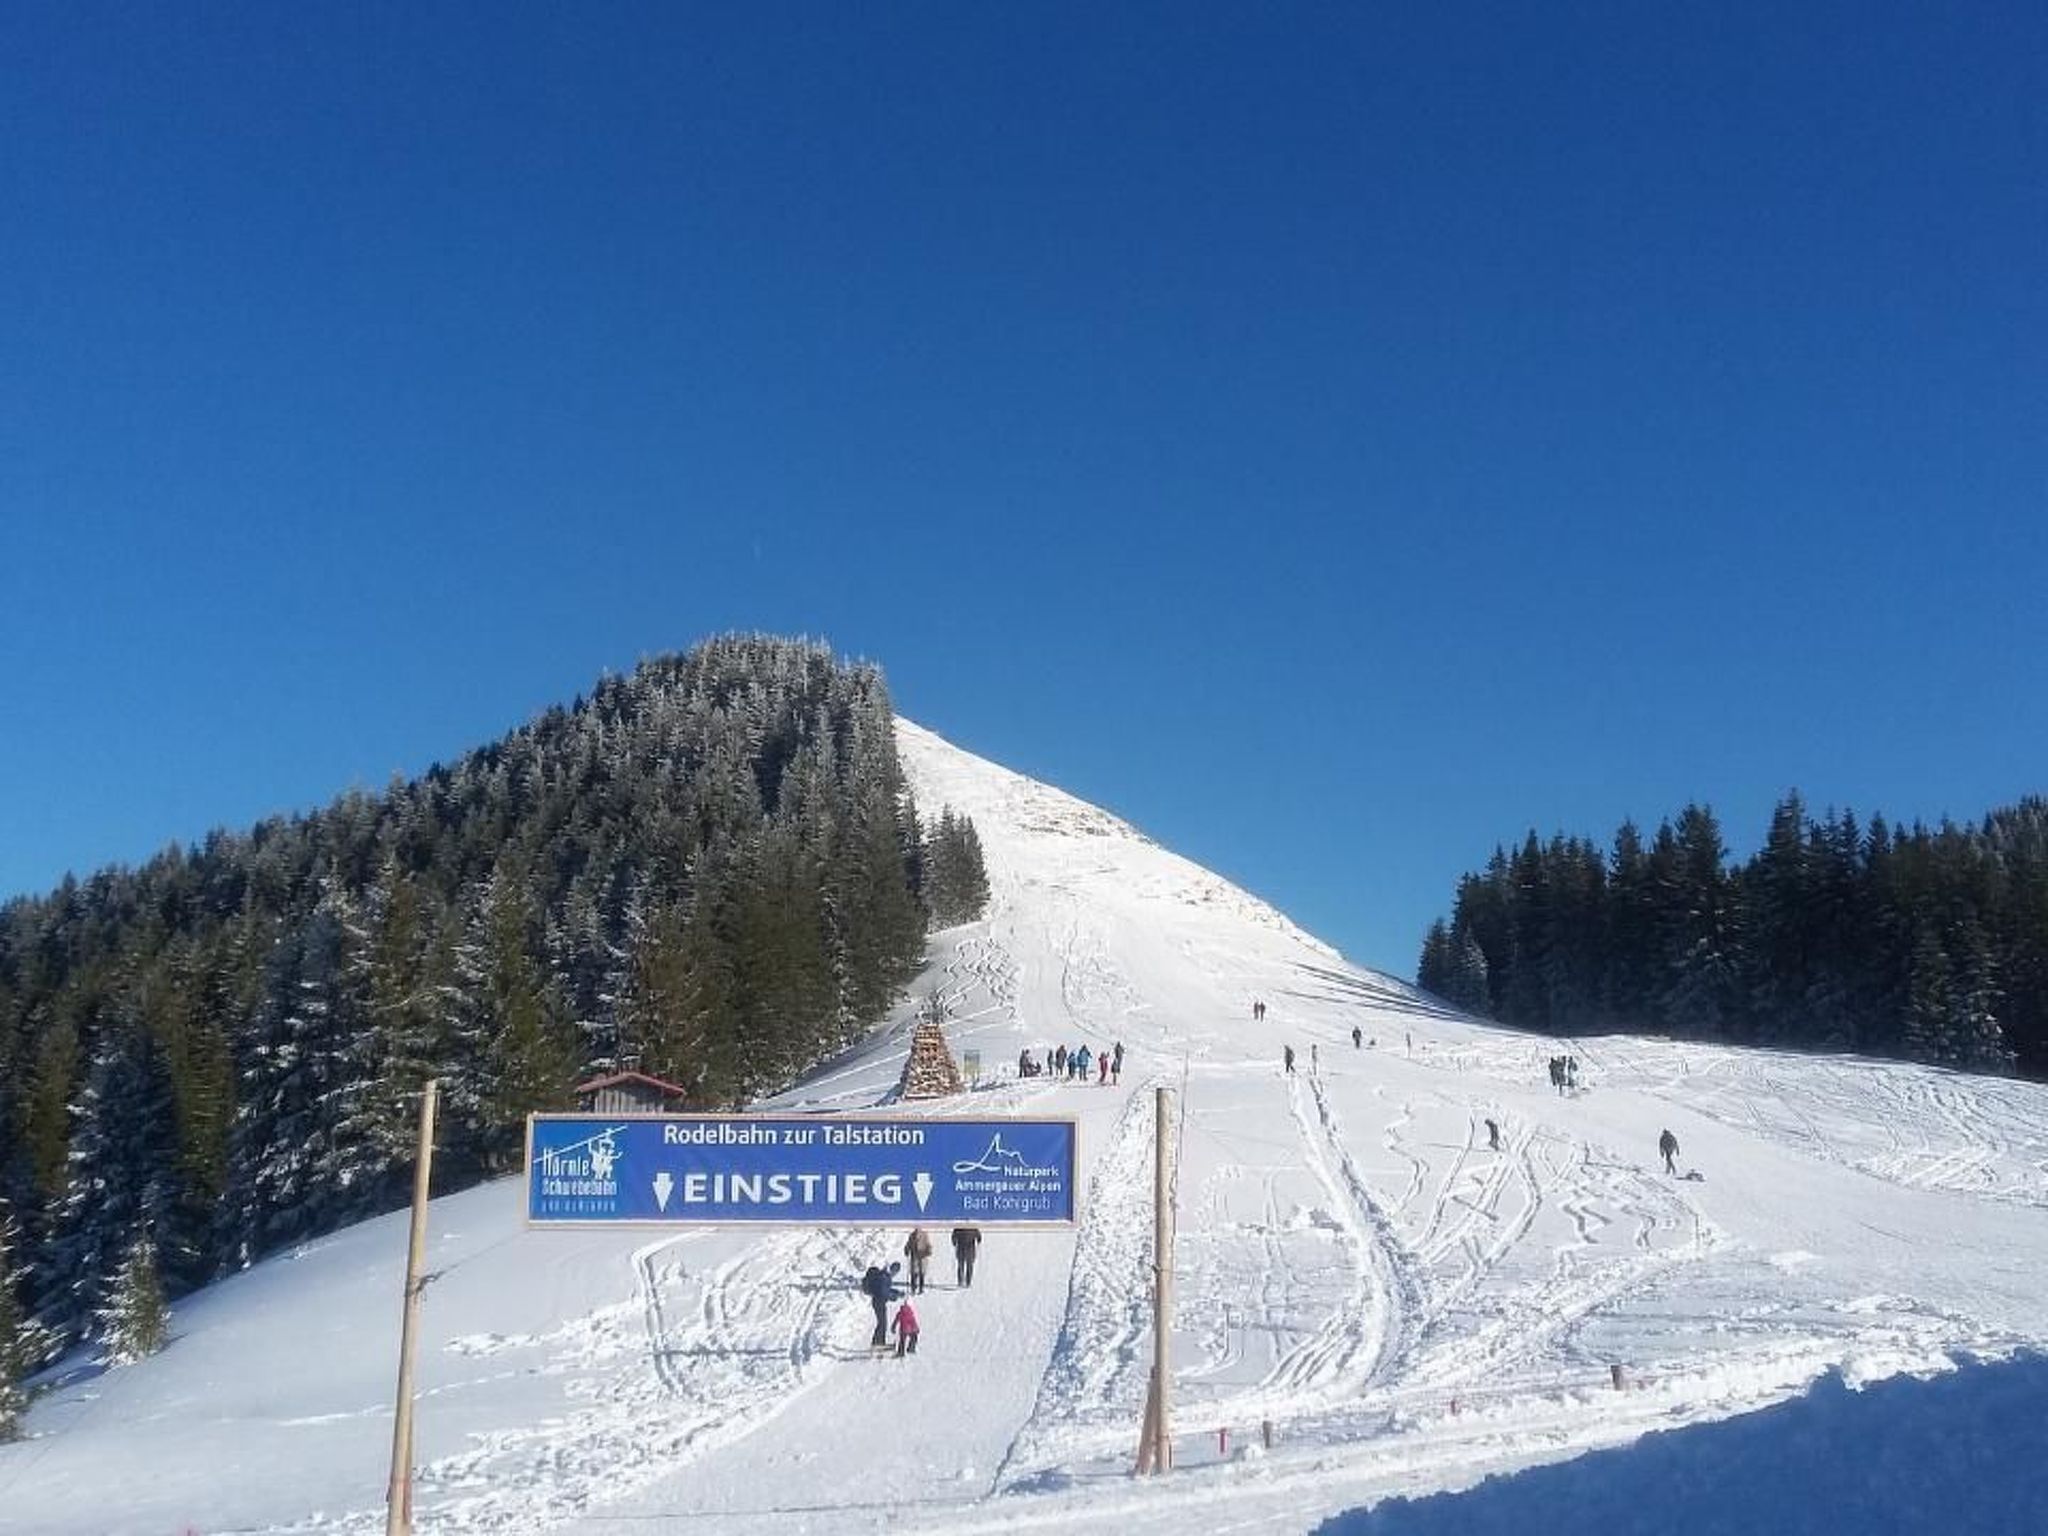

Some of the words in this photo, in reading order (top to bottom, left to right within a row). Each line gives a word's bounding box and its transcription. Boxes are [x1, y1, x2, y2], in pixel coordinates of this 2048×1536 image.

[663, 1124, 777, 1145] Rodelbahn
[782, 1129, 815, 1145] zur
[822, 1125, 925, 1145] Talstation
[1003, 1165, 1060, 1178] Naturpark
[683, 1173, 902, 1204] EINSTIEG
[955, 1179, 1026, 1193] Ammergauer
[1029, 1180, 1062, 1193] Alpen
[963, 1197, 989, 1209] Bad
